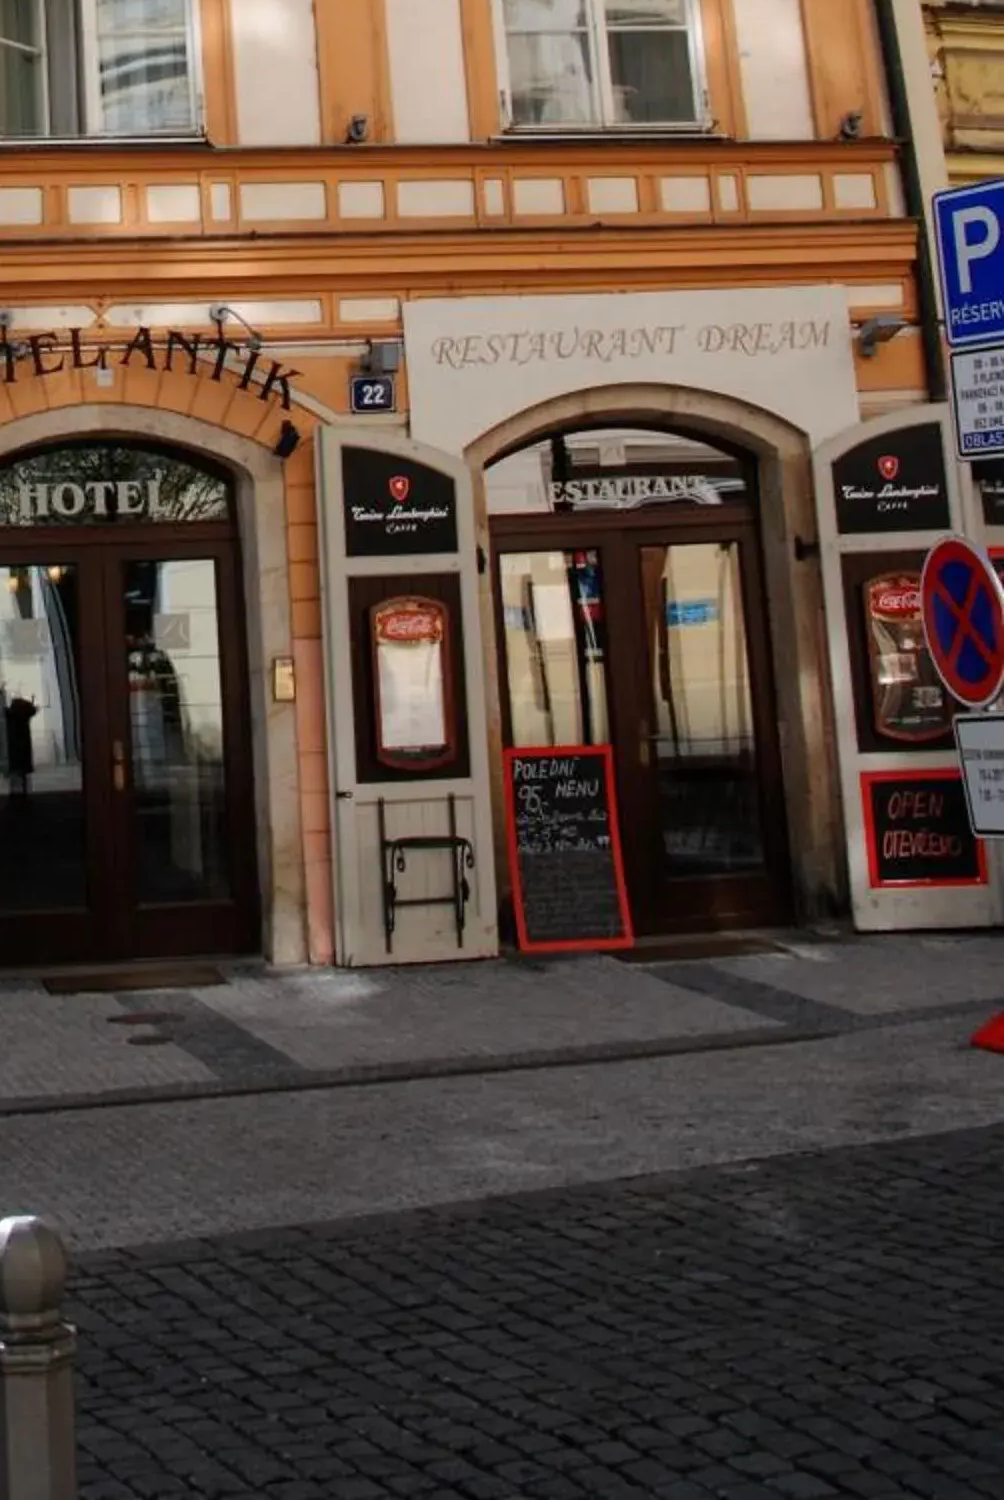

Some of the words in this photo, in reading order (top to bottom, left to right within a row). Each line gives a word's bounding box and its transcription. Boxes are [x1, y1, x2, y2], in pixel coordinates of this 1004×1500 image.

[952, 205, 1000, 295] P
[431, 325, 684, 369] RESTAURANT
[698, 320, 832, 357] DREAM
[120, 326, 302, 411] ANTIK
[362, 384, 385, 405] 22
[19, 479, 168, 518] HOTEL
[534, 474, 707, 504] ESTAURANT
[514, 756, 580, 780] POLEDNÍ
[555, 779, 599, 798] MENU
[887, 790, 945, 820] OPEN
